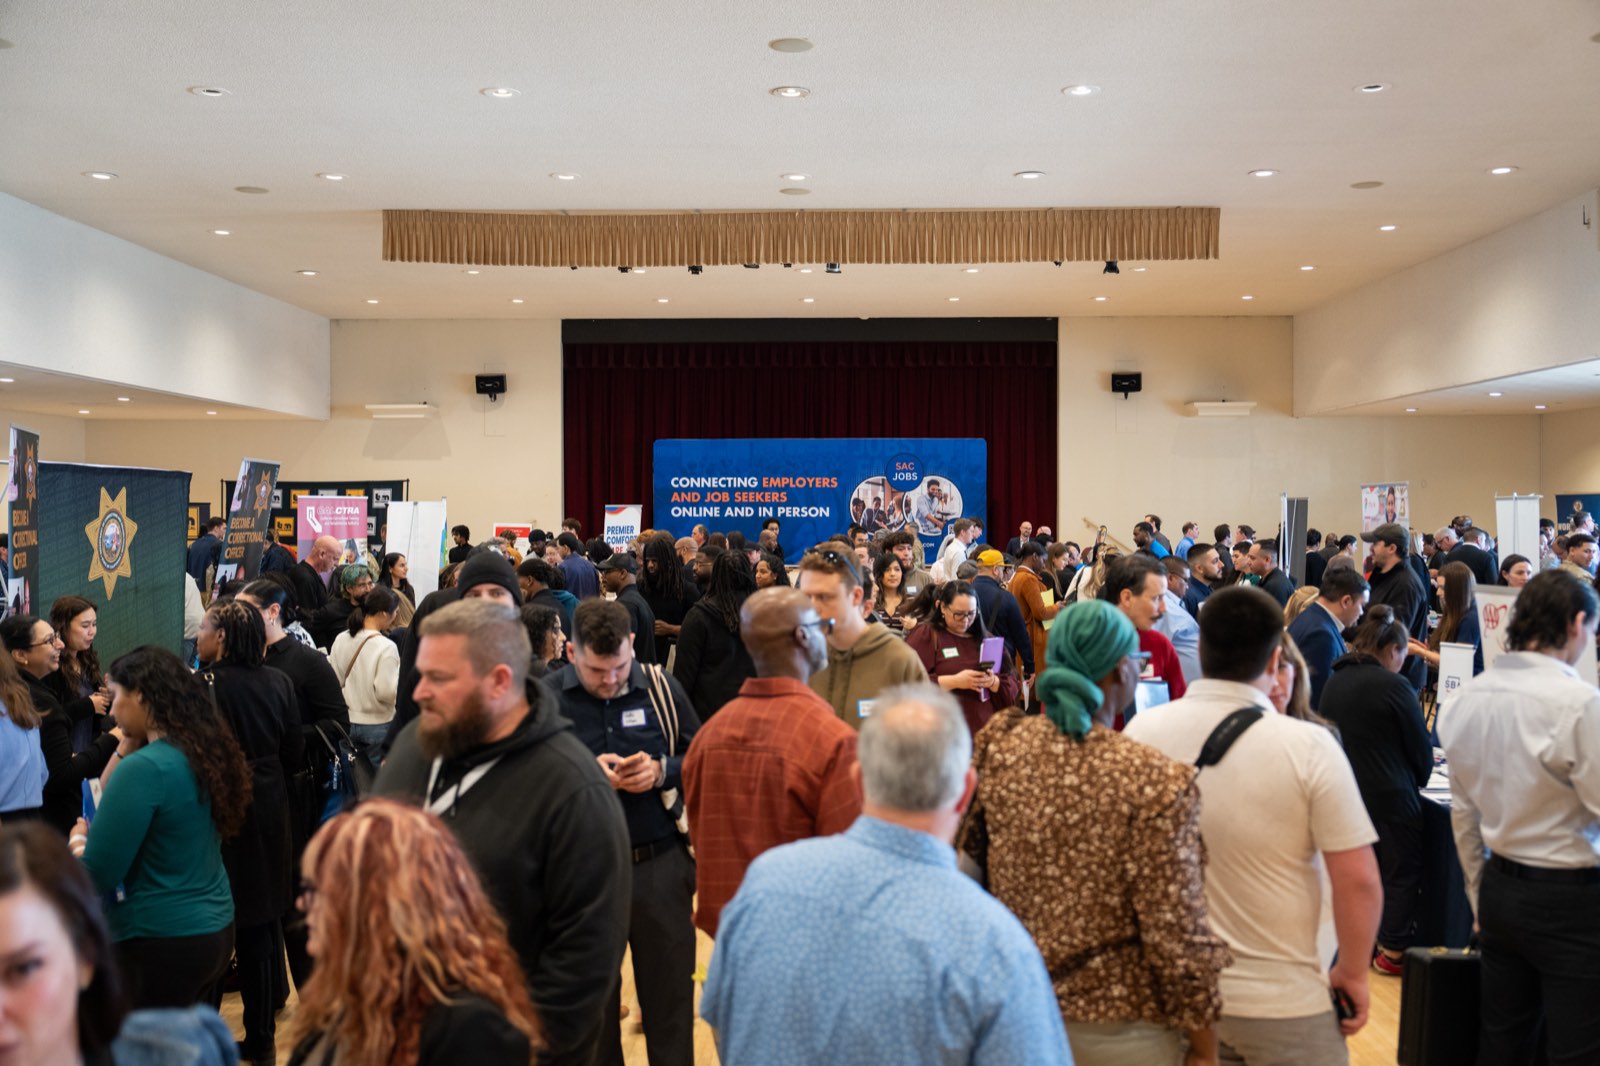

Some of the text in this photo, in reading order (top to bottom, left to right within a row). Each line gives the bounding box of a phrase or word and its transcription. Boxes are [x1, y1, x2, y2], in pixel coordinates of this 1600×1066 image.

[896, 462, 915, 471] SAC
[892, 472, 918, 481] JOBS
[671, 477, 838, 488] CONNECTING EMPLOYERS
[671, 492, 788, 503] AND JOB SEEKERS
[671, 507, 830, 518] ONLINE AND IN PERSON
[230, 517, 251, 529] BECOME
[606, 525, 635, 535] PREMIER
[227, 531, 264, 544] CORRECTIONAL
